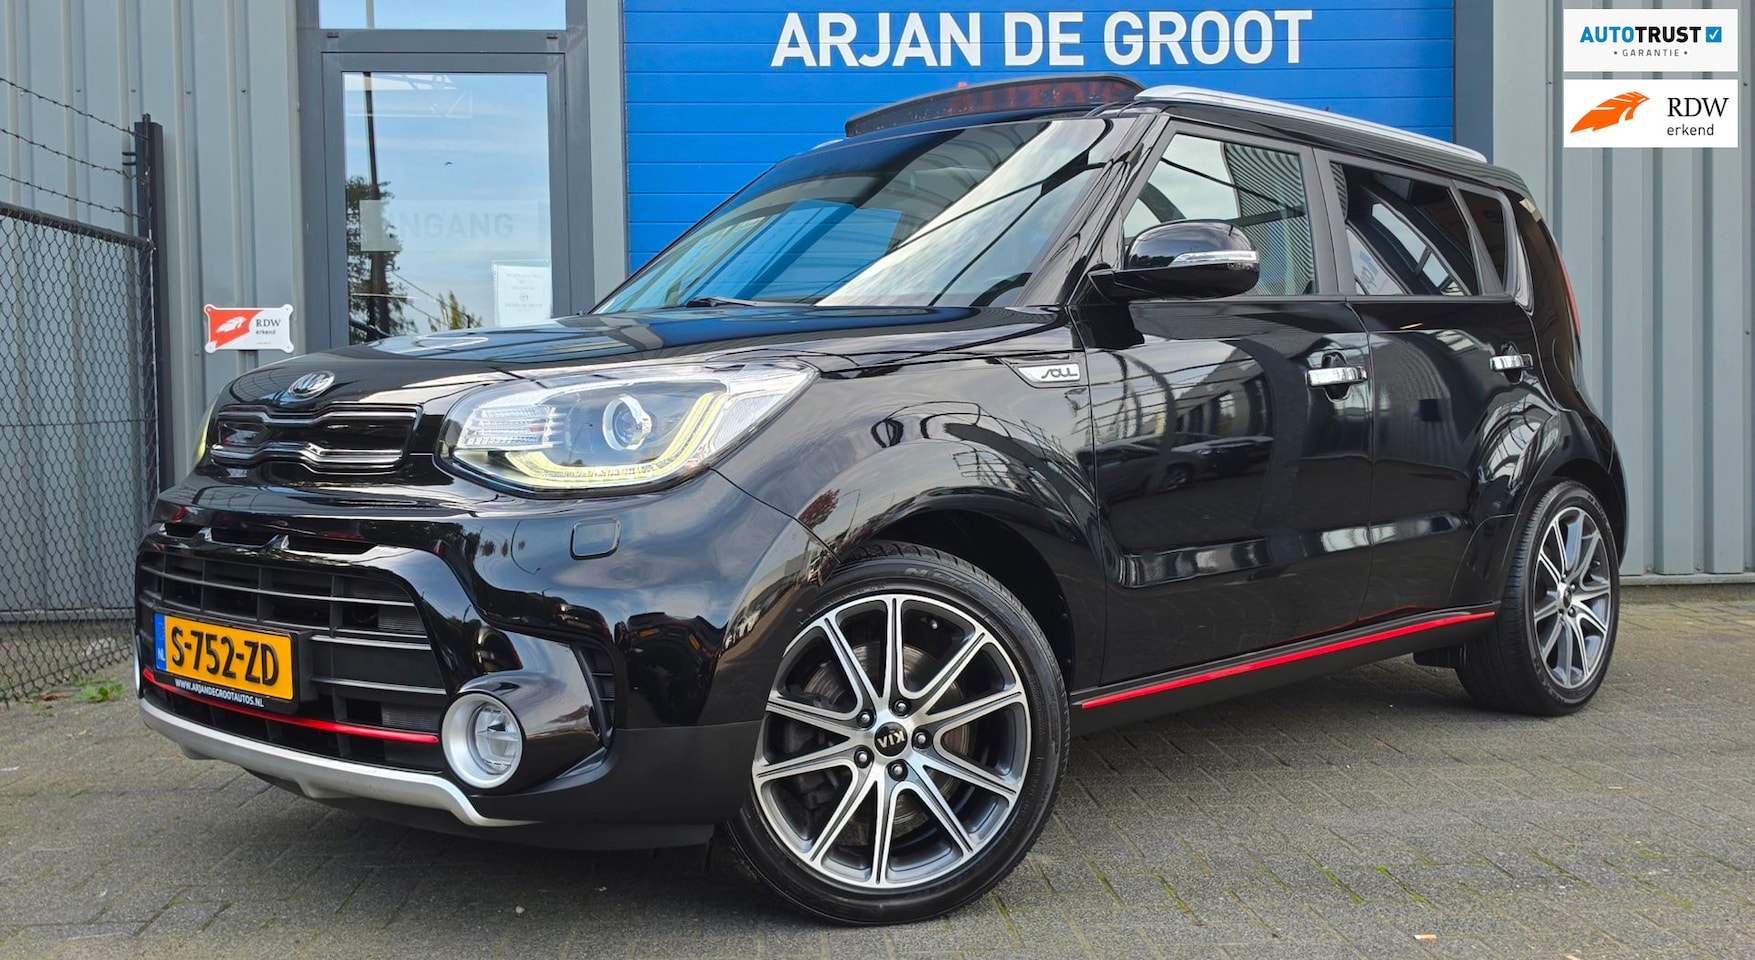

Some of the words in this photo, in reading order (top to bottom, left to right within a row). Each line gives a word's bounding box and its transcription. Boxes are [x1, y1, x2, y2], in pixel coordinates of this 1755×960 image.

[770, 11, 982, 68] ARJAN
[1003, 11, 1085, 67] DE
[1103, 9, 1313, 66] GROOT
[255, 318, 282, 328] RDW
[1041, 367, 1079, 379] SOUL
[157, 647, 166, 662] NL
[171, 626, 279, 686] S-752-ZD
[174, 678, 264, 708] WWW.ARJANDEGROOTAUTOS.NL
[876, 730, 906, 748] KIA
